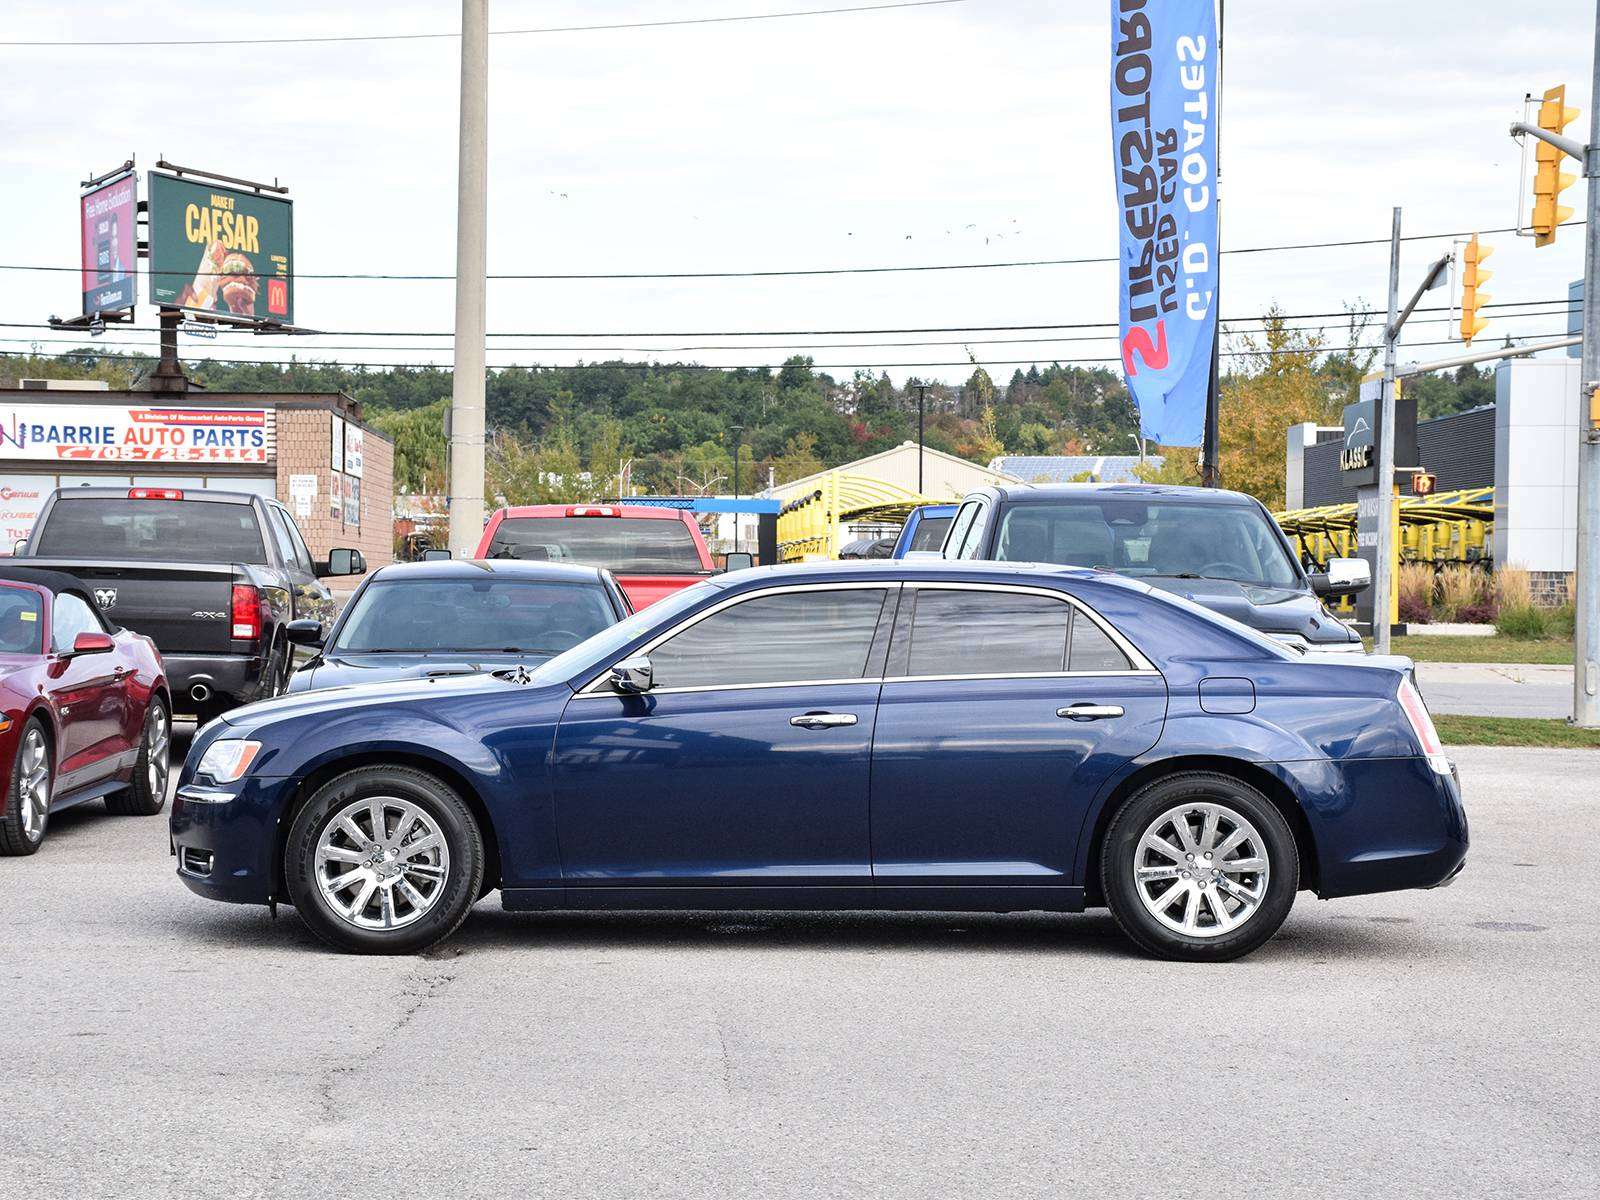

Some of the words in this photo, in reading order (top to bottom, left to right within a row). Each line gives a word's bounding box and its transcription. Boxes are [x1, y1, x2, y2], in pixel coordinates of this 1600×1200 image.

[185, 203, 259, 254] CAESAR
[178, 414, 213, 422] Newmarket
[31, 425, 115, 444] BARRIE
[124, 427, 185, 445] AUTO
[193, 429, 263, 447] PARTS
[91, 446, 258, 461] 705-725-1114
[1340, 445, 1368, 471] KLASSIC
